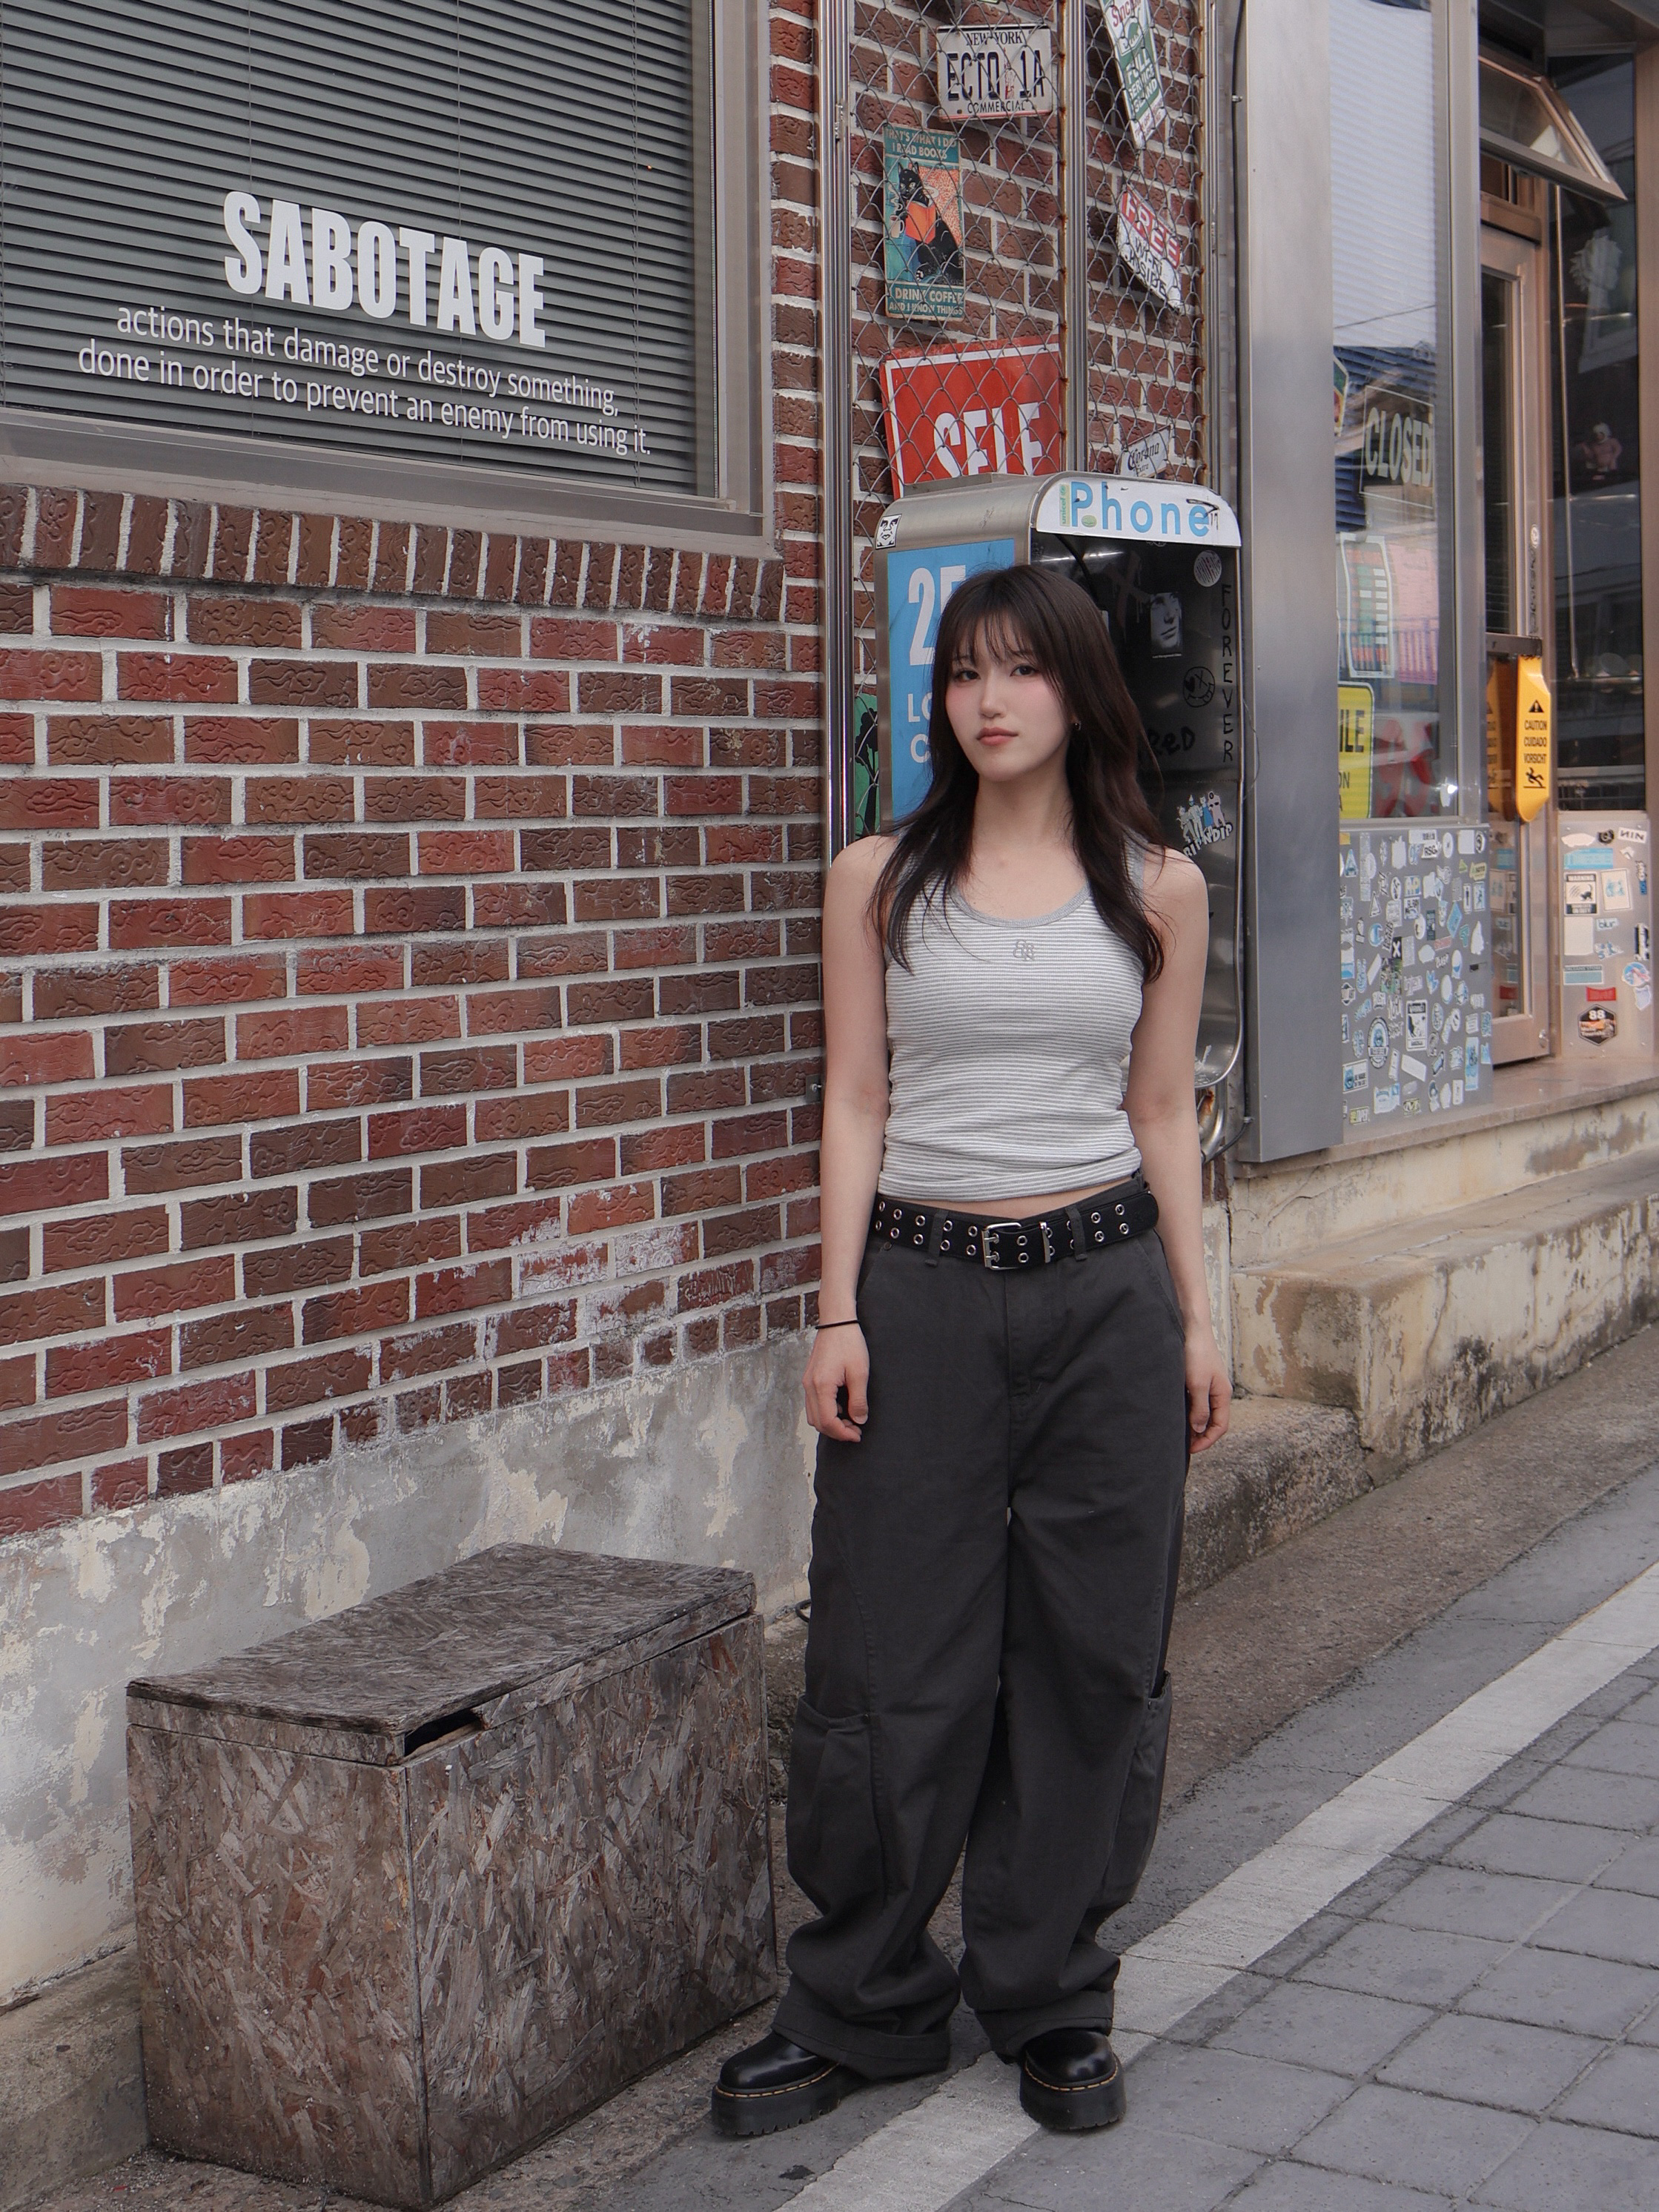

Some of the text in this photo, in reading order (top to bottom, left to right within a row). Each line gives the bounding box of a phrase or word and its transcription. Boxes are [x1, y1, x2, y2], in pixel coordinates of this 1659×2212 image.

[966, 31, 1023, 46] NEW YORK
[947, 50, 1044, 101] ECTO 1A
[967, 101, 1025, 113] COMMERCIAL
[893, 142, 947, 159] I READ BOOKS
[1125, 191, 1179, 267] FREE
[223, 191, 547, 348] SABOTAGE
[895, 287, 964, 304] DRINK COFFEE
[890, 301, 963, 315] AND I KNOW THINGS
[117, 305, 619, 417] actions that damage or destroy something,
[78, 339, 652, 456] done in order to prevent an enemy from using it.
[1365, 407, 1432, 487] CLOSED
[1071, 481, 1210, 537] Phone
[1222, 584, 1234, 763] FOREVER
[1524, 720, 1547, 730] CAUTION
[1524, 736, 1547, 747] CUIDADO
[1523, 752, 1547, 764] VORSICHT
[1589, 1009, 1606, 1021] 88
